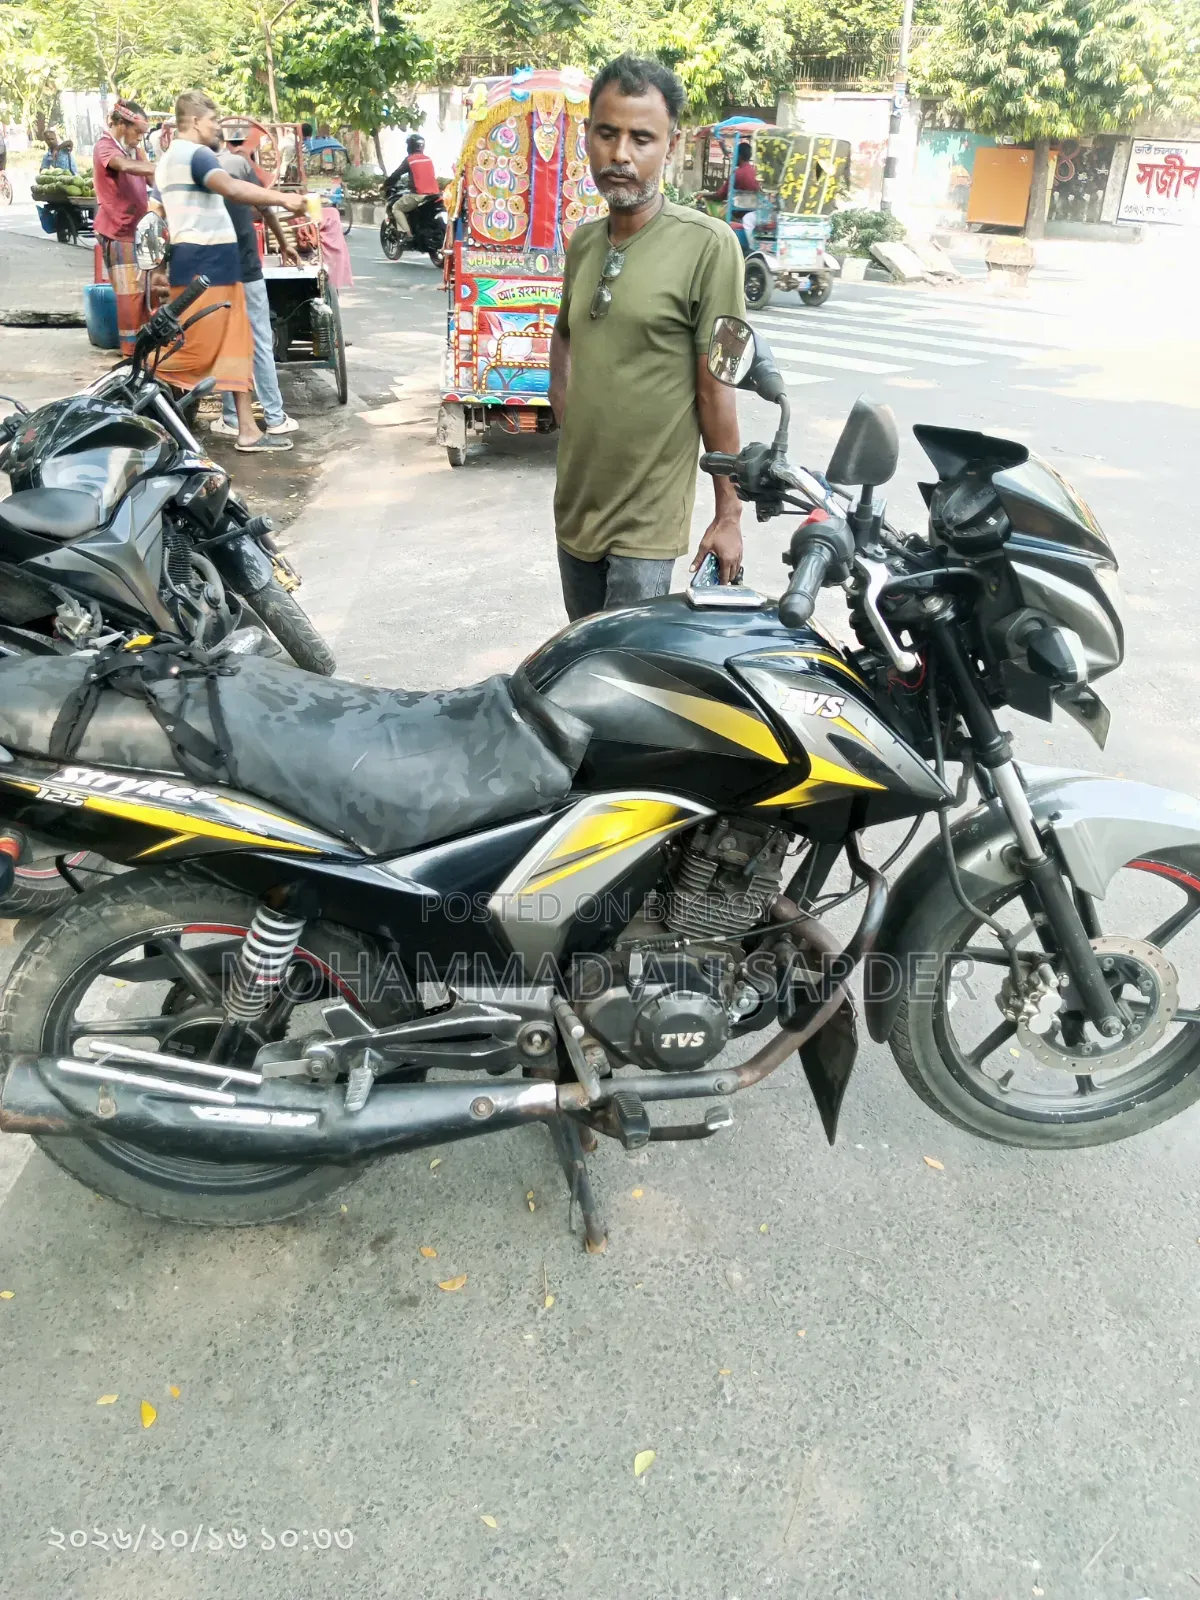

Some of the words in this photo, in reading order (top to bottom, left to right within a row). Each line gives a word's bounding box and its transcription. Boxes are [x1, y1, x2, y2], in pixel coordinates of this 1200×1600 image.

[516, 286, 549, 298] রহমান
[780, 687, 847, 719] TVS
[35, 786, 90, 807] 125
[660, 1031, 706, 1048] TVS
